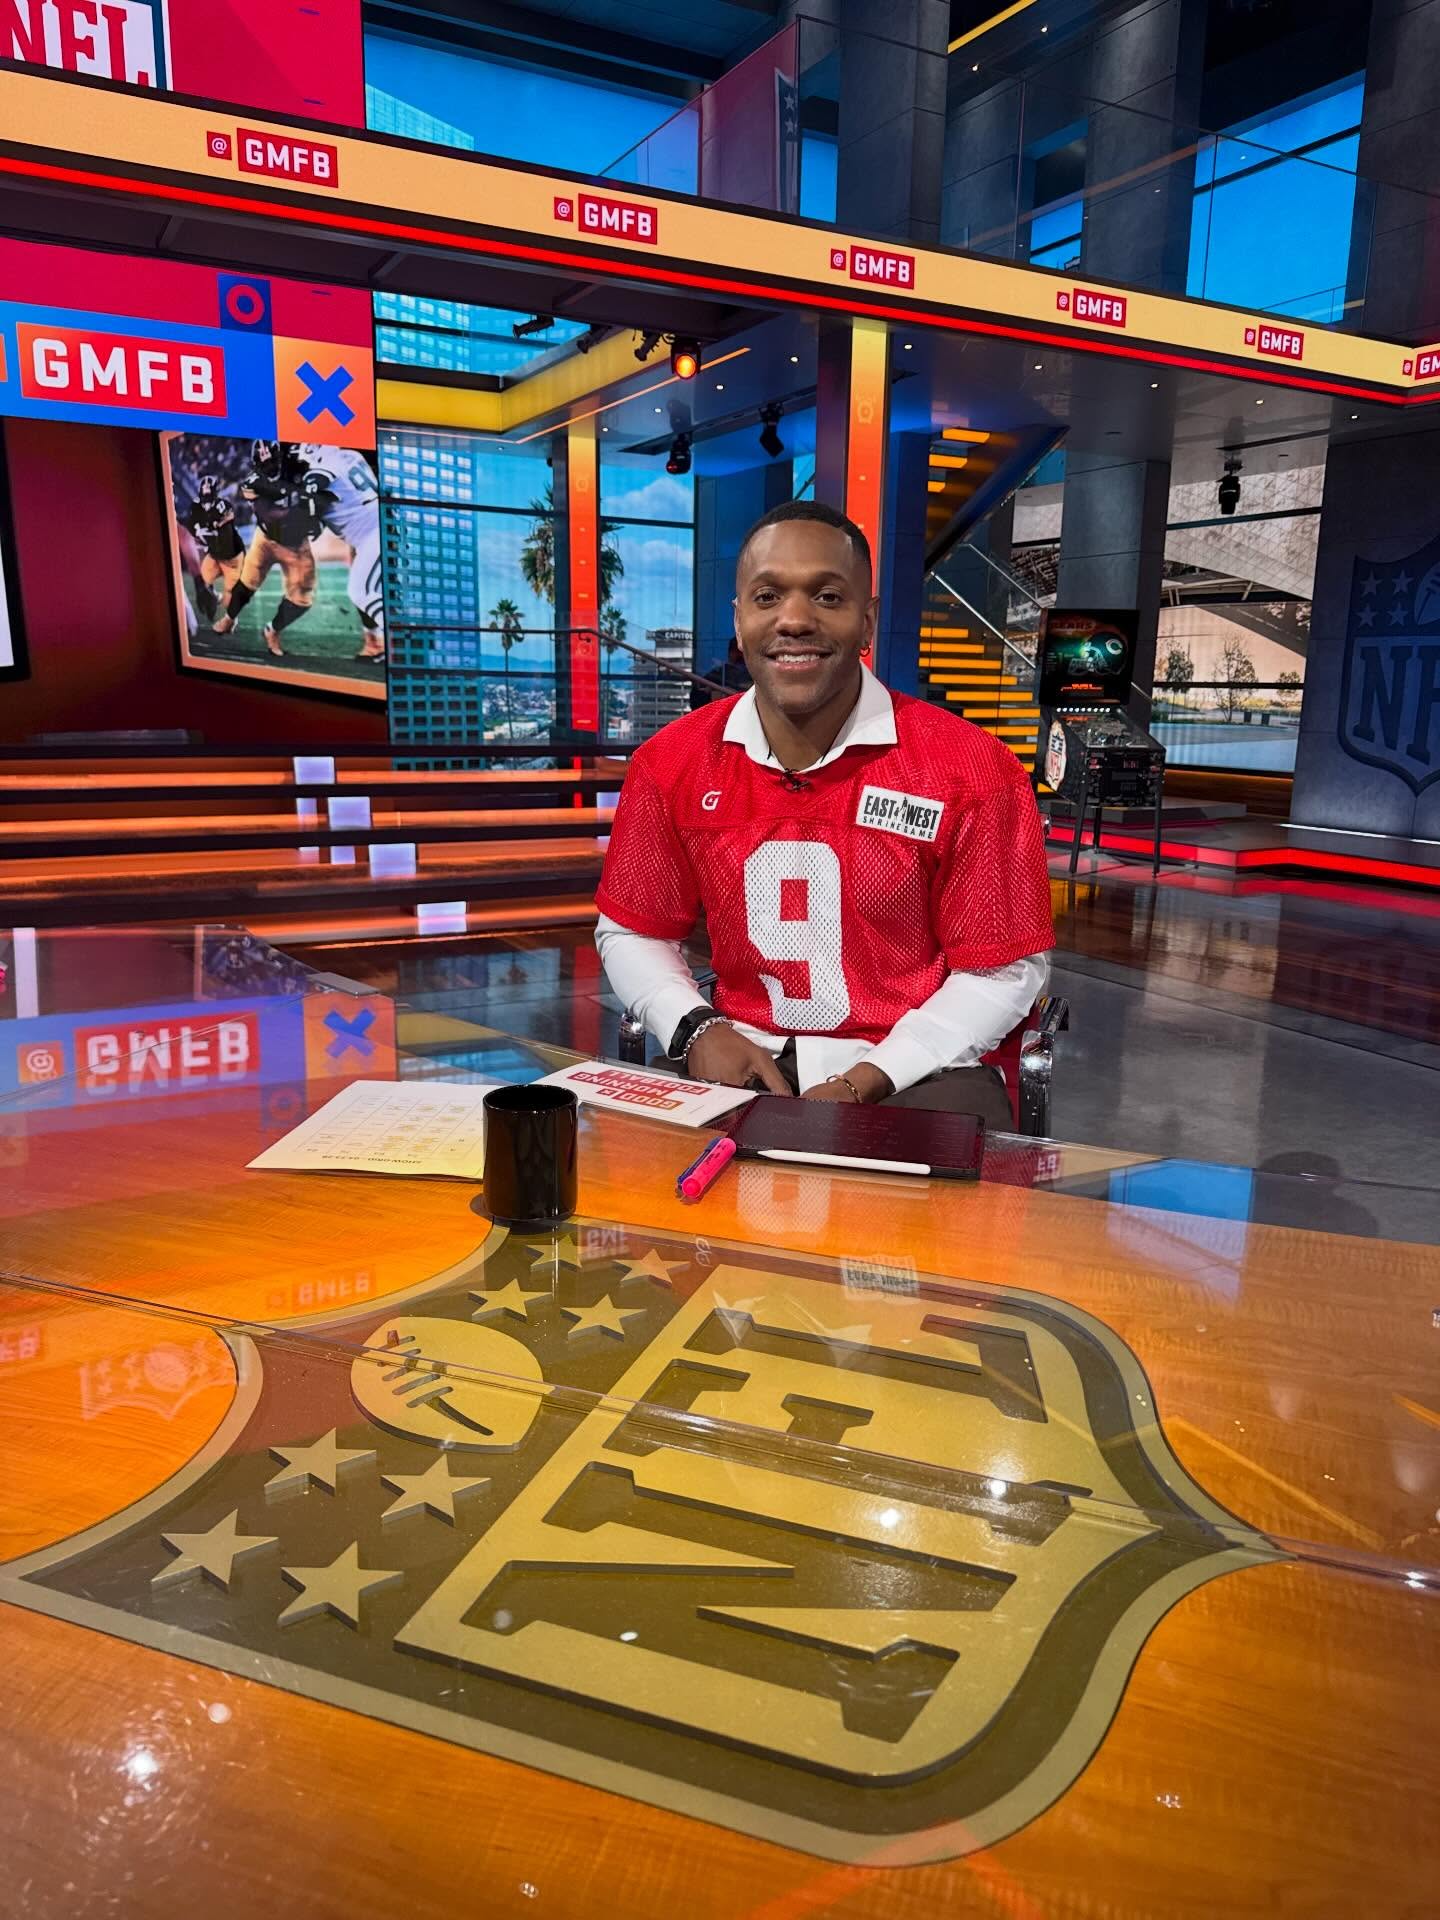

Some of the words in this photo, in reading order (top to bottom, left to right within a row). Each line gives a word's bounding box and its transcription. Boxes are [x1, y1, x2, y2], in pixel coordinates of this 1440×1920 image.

[0, 0, 150, 86] NFL
[211, 137, 228, 155] @
[245, 138, 331, 179] GMFB
[557, 201, 571, 218] @
[584, 202, 652, 237] GMFB
[854, 252, 910, 283] GMFB
[1076, 294, 1123, 322] GMFB
[1260, 330, 1301, 355] GMFB
[31, 337, 215, 404] GMFB
[863, 794, 897, 819] EAST
[905, 803, 940, 831] WEST
[743, 839, 851, 1032] 9
[574, 1072, 669, 1097] MORNING
[608, 1070, 707, 1095] FOOTBALL
[618, 1092, 677, 1109] GOOD
[460, 1307, 1093, 1743] NFL
